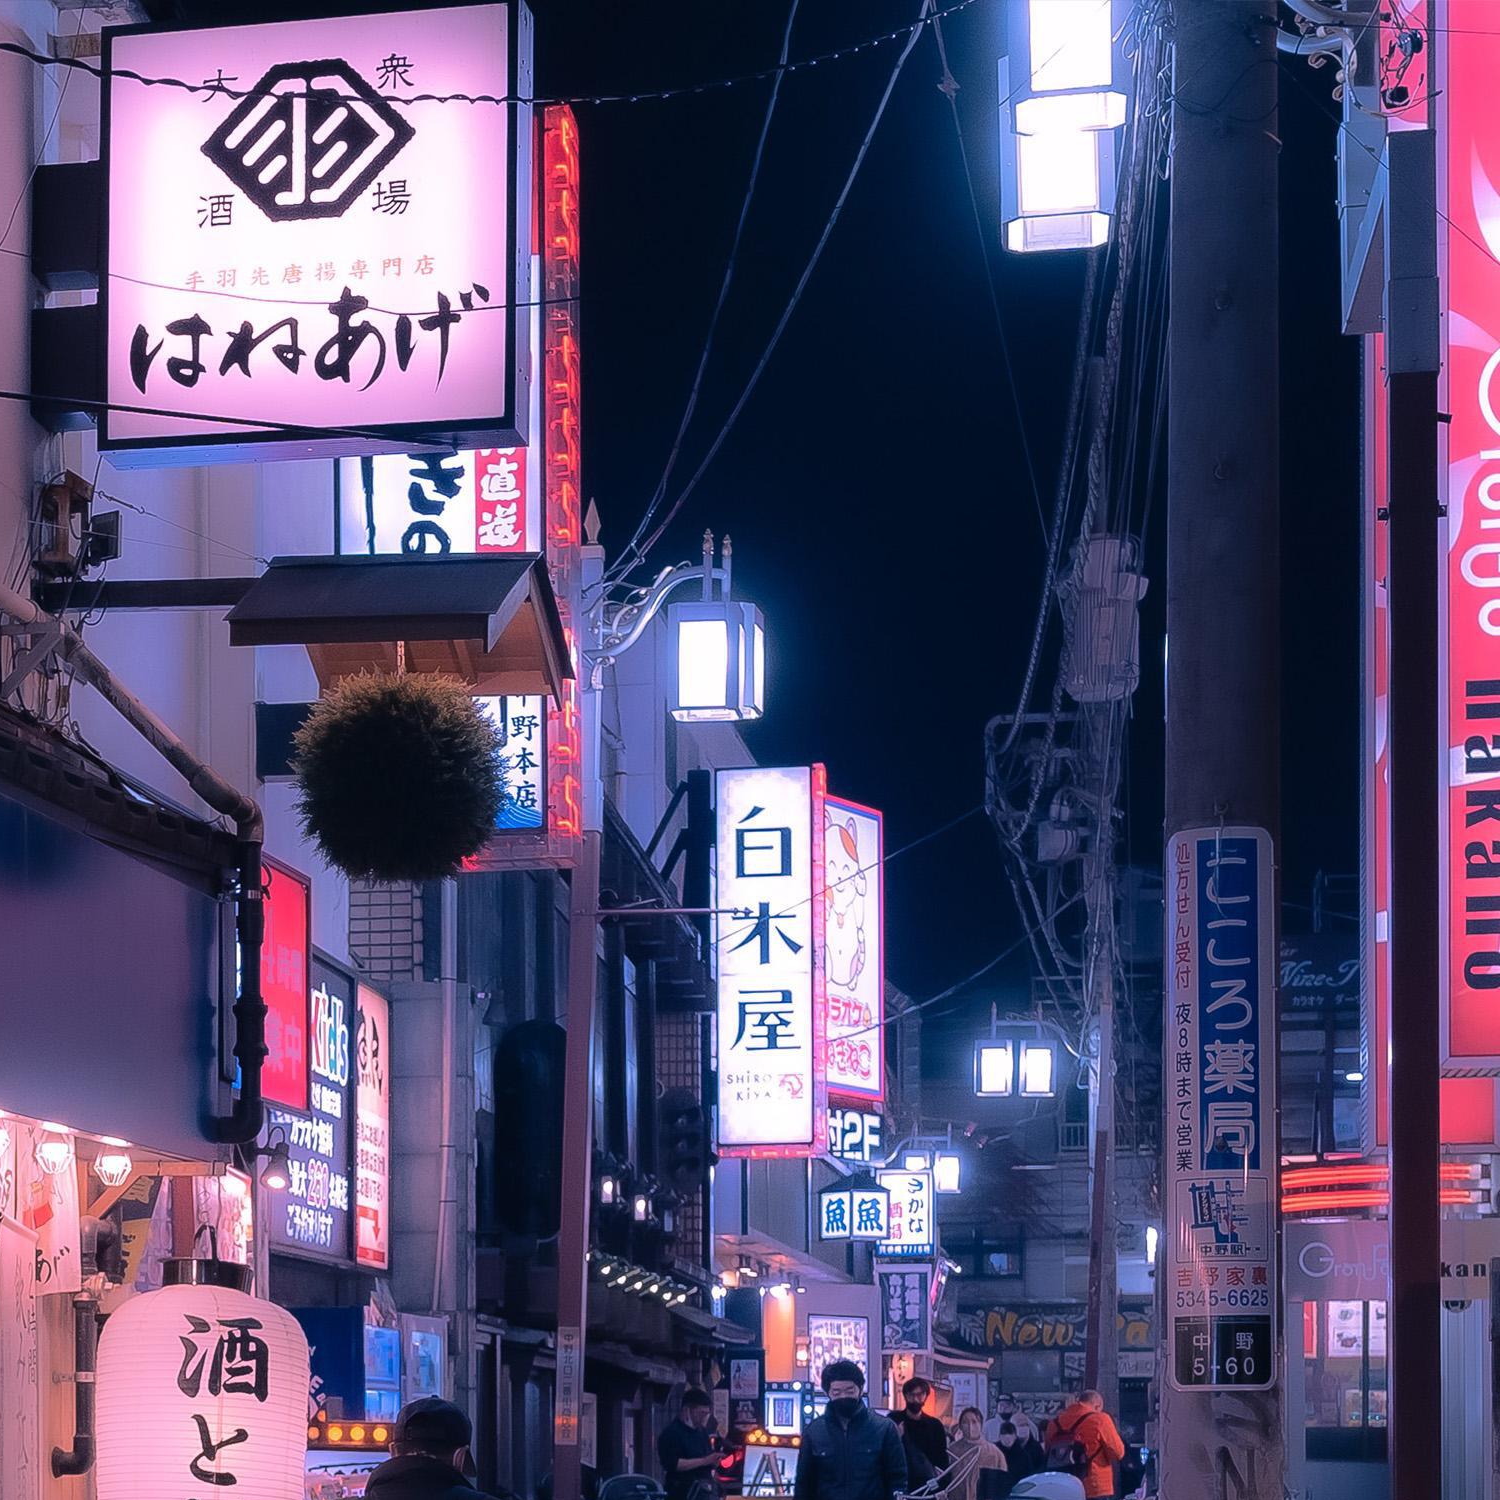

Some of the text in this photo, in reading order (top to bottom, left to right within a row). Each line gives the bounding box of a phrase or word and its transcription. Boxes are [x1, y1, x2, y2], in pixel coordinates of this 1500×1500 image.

[130, 283, 491, 394] はねあげ
[478, 447, 523, 548] 直送
[510, 697, 540, 810] 野本店
[726, 806, 804, 1052] 白木屋
[825, 996, 863, 1027] ラオケ
[1175, 841, 1193, 1173] 処方せん受付 夜8時まで営業
[1203, 855, 1256, 1156] こころ薬局
[825, 1197, 847, 1234] 魚
[857, 1197, 884, 1233] 魚
[1177, 1266, 1268, 1287] 吉野家裏
[1177, 1289, 1268, 1308] 5345-6625
[985, 1311, 1074, 1346] New
[1193, 1357, 1255, 1375] 5-60
